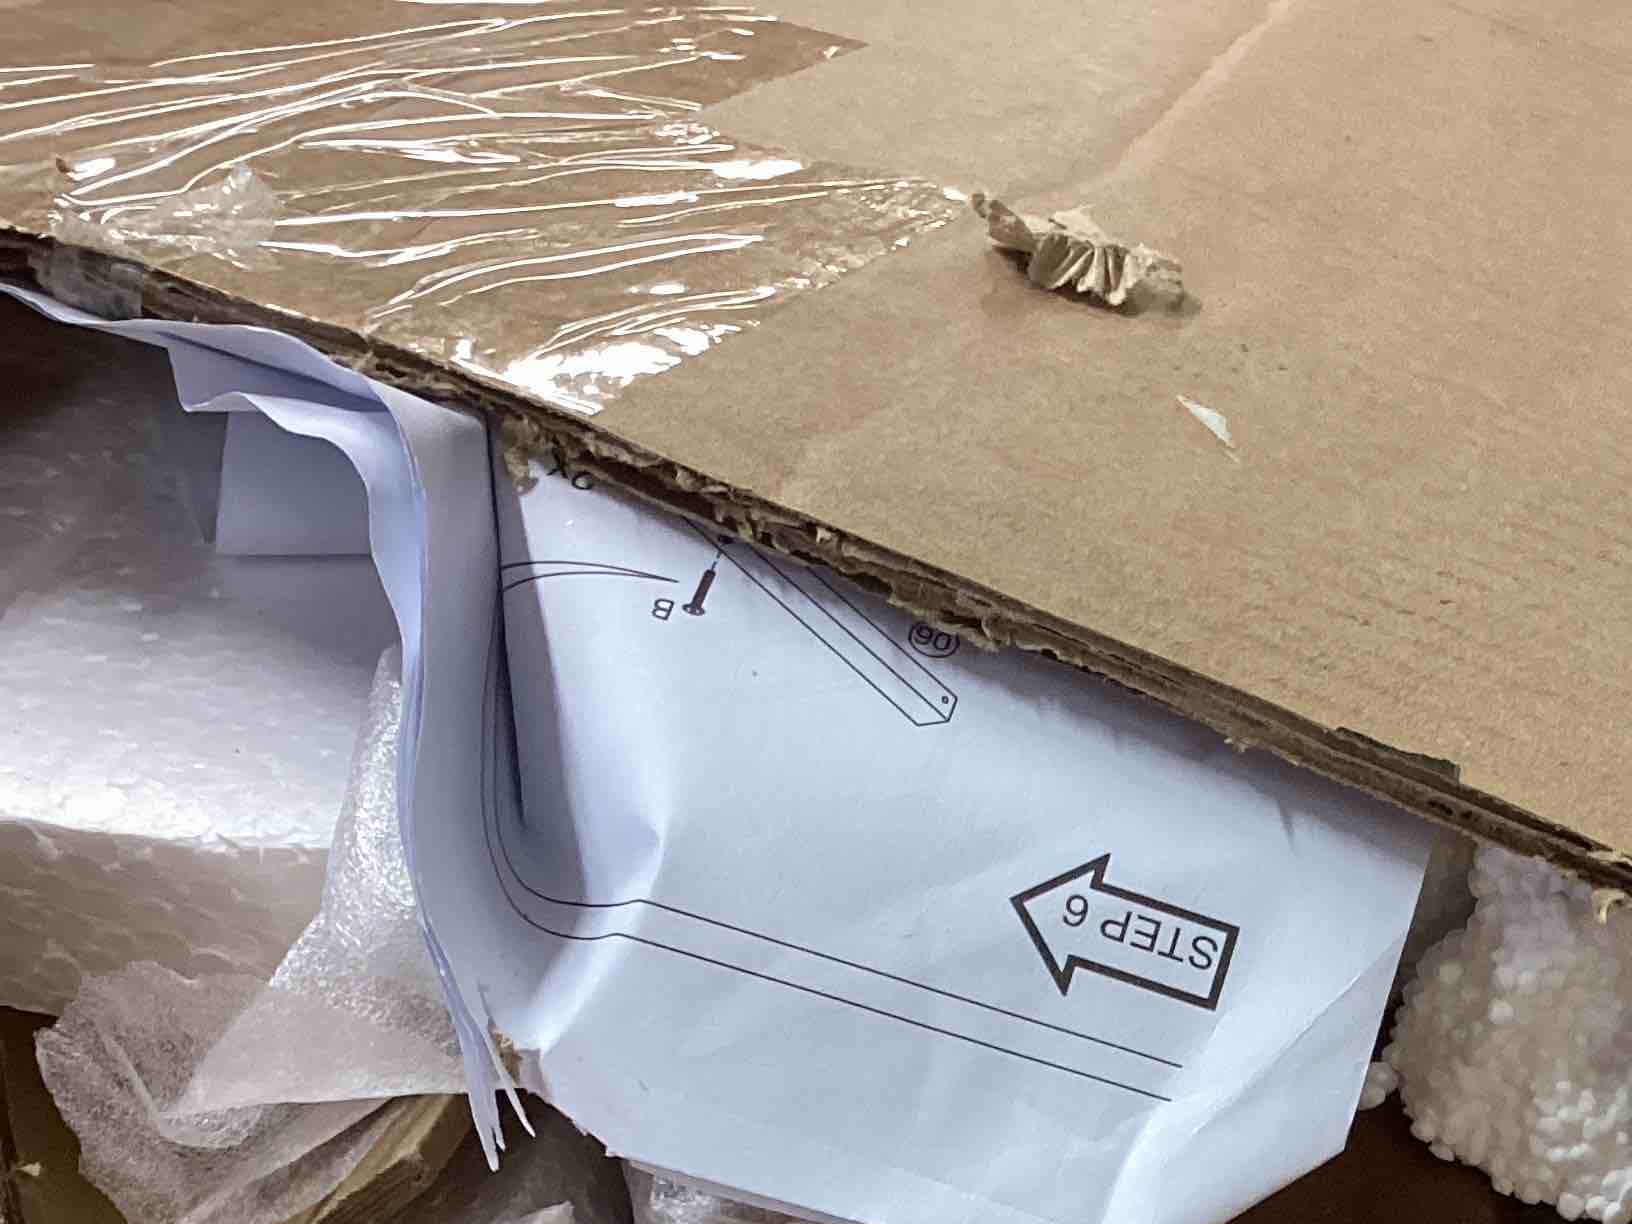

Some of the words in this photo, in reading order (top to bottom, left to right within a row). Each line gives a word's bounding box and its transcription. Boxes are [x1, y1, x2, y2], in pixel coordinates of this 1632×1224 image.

[651, 598, 675, 621] B
[1063, 894, 1089, 928] 6
[1101, 910, 1219, 971] STEP
